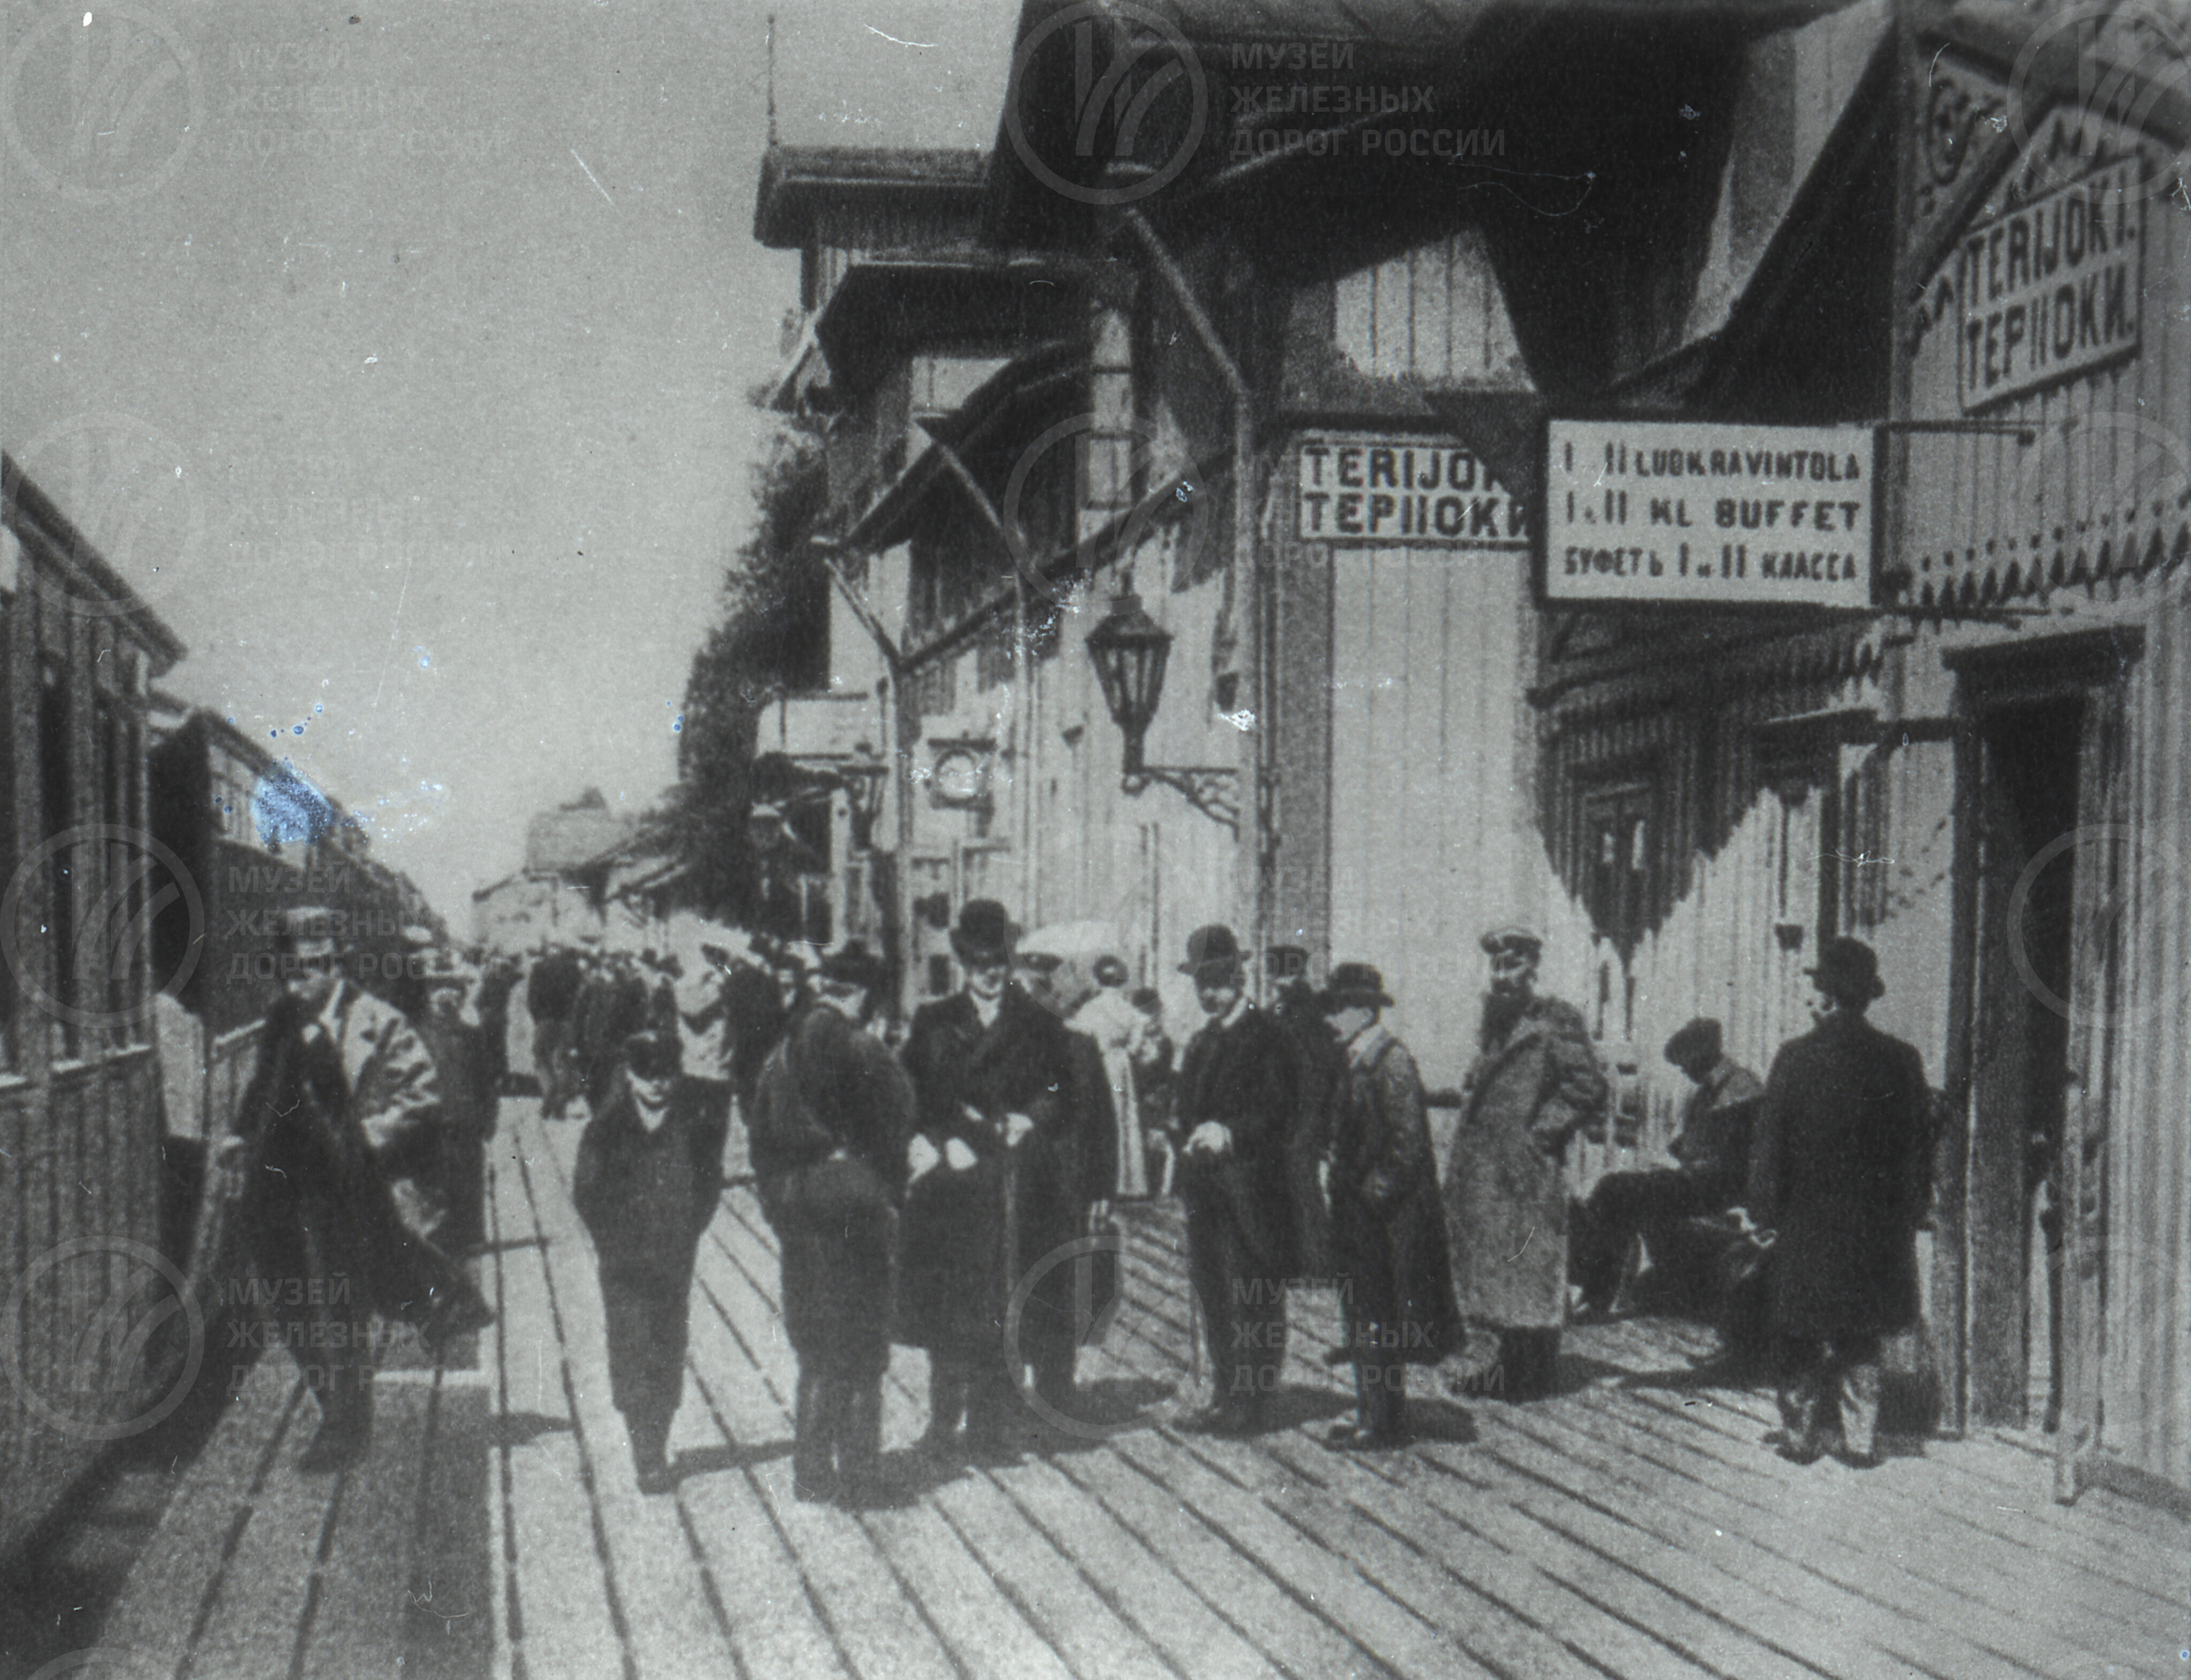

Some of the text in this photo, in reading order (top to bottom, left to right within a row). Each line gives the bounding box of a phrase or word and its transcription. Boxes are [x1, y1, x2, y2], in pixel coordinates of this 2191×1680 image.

[1605, 488, 1627, 525] II
[1715, 498, 1860, 531] BUFFET
[1721, 544, 1746, 579] II
[1762, 551, 1857, 581] КЛАССА
